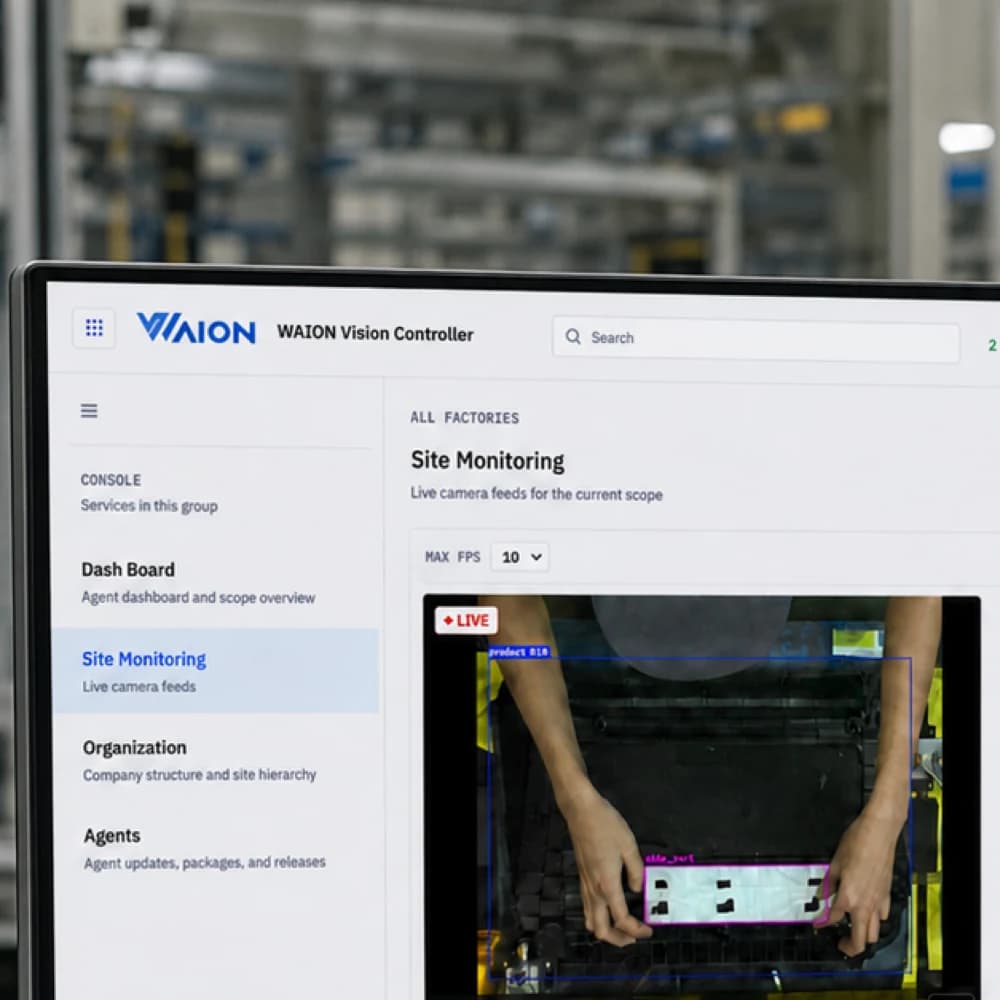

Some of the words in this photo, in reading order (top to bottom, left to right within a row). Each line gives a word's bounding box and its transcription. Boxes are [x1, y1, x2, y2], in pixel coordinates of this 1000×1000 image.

[137, 312, 256, 344] WAION
[277, 324, 336, 339] WAION
[341, 325, 389, 340] Vision
[394, 326, 474, 342] Controller
[592, 331, 634, 344] Search
[989, 339, 997, 352] 2
[411, 411, 435, 423] ALL
[445, 411, 520, 424] FACTORIES
[412, 450, 450, 469] Site
[457, 451, 565, 475] Monitoring
[81, 473, 141, 486] CONSOLE
[411, 486, 437, 499] Live
[440, 489, 488, 499] camera
[491, 486, 527, 500] feeds
[530, 487, 549, 500] for
[552, 487, 572, 500] the
[576, 489, 622, 501] current
[625, 491, 663, 504] scope
[81, 498, 136, 512] Services
[139, 499, 151, 512] in
[153, 499, 178, 512] this
[181, 501, 218, 516] group
[425, 551, 449, 562] MAX
[458, 551, 480, 563] FPS
[503, 551, 520, 563] 10
[82, 562, 122, 577] Dash
[127, 562, 175, 577] Board
[81, 590, 119, 606] Agent
[121, 590, 189, 603] dashboard
[192, 592, 216, 603] and
[219, 594, 257, 606] scope
[259, 592, 316, 604] overview
[457, 614, 489, 627] LIVE
[83, 651, 114, 666] Site
[119, 651, 207, 670] Monitoring
[83, 680, 108, 693] Live
[111, 683, 159, 692] camera
[161, 680, 196, 692] feeds
[83, 740, 187, 759] Organization
[83, 769, 143, 784] Company
[146, 769, 203, 781] structure
[206, 768, 230, 781] and
[233, 768, 255, 781] site
[258, 768, 316, 783] hierarchy
[84, 828, 141, 847] Agents
[84, 857, 121, 873] Agent
[125, 857, 179, 872] updates,
[182, 856, 244, 872] packages,
[248, 856, 271, 868] and
[274, 856, 326, 868] releases
